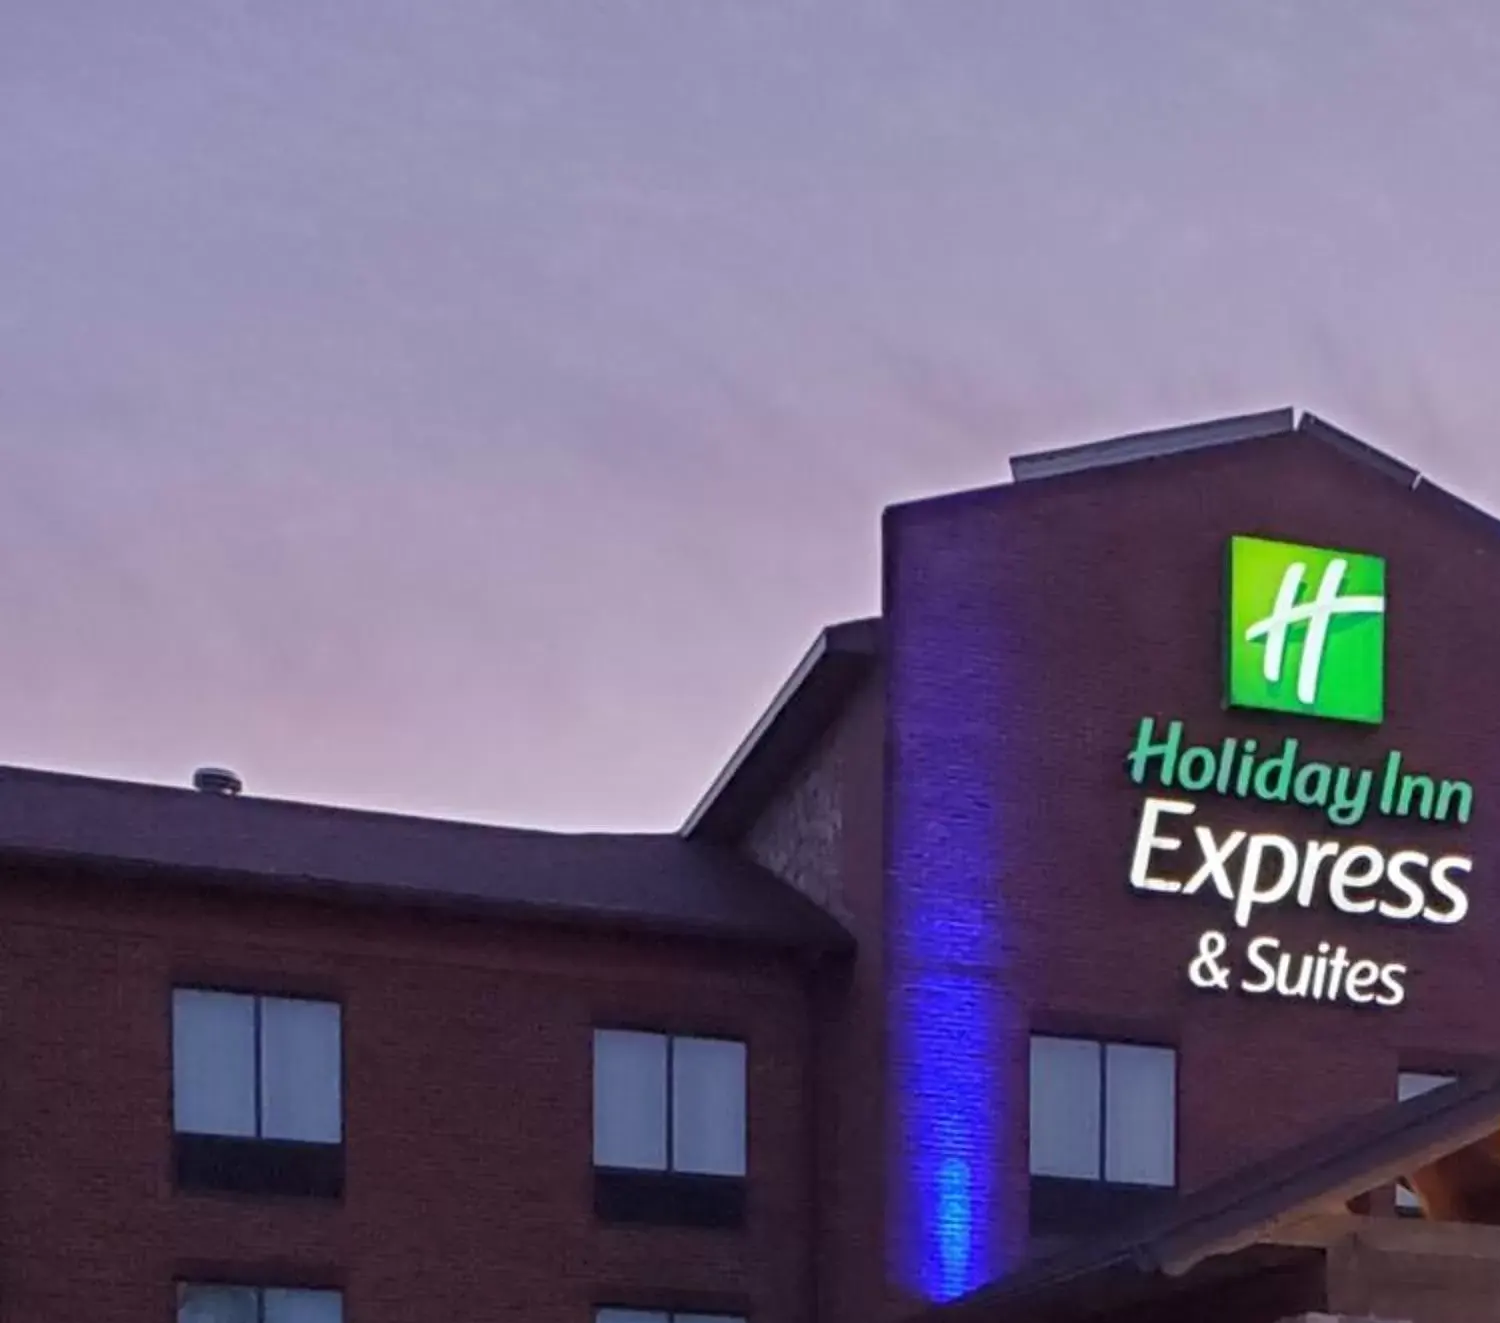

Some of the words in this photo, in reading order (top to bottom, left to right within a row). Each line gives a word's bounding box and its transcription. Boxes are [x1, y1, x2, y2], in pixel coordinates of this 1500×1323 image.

[1127, 716, 1372, 826] Holiday
[1382, 750, 1474, 825] Inn
[1129, 797, 1474, 928] Express
[1188, 931, 1231, 991] &
[1241, 936, 1408, 1007] Suites
